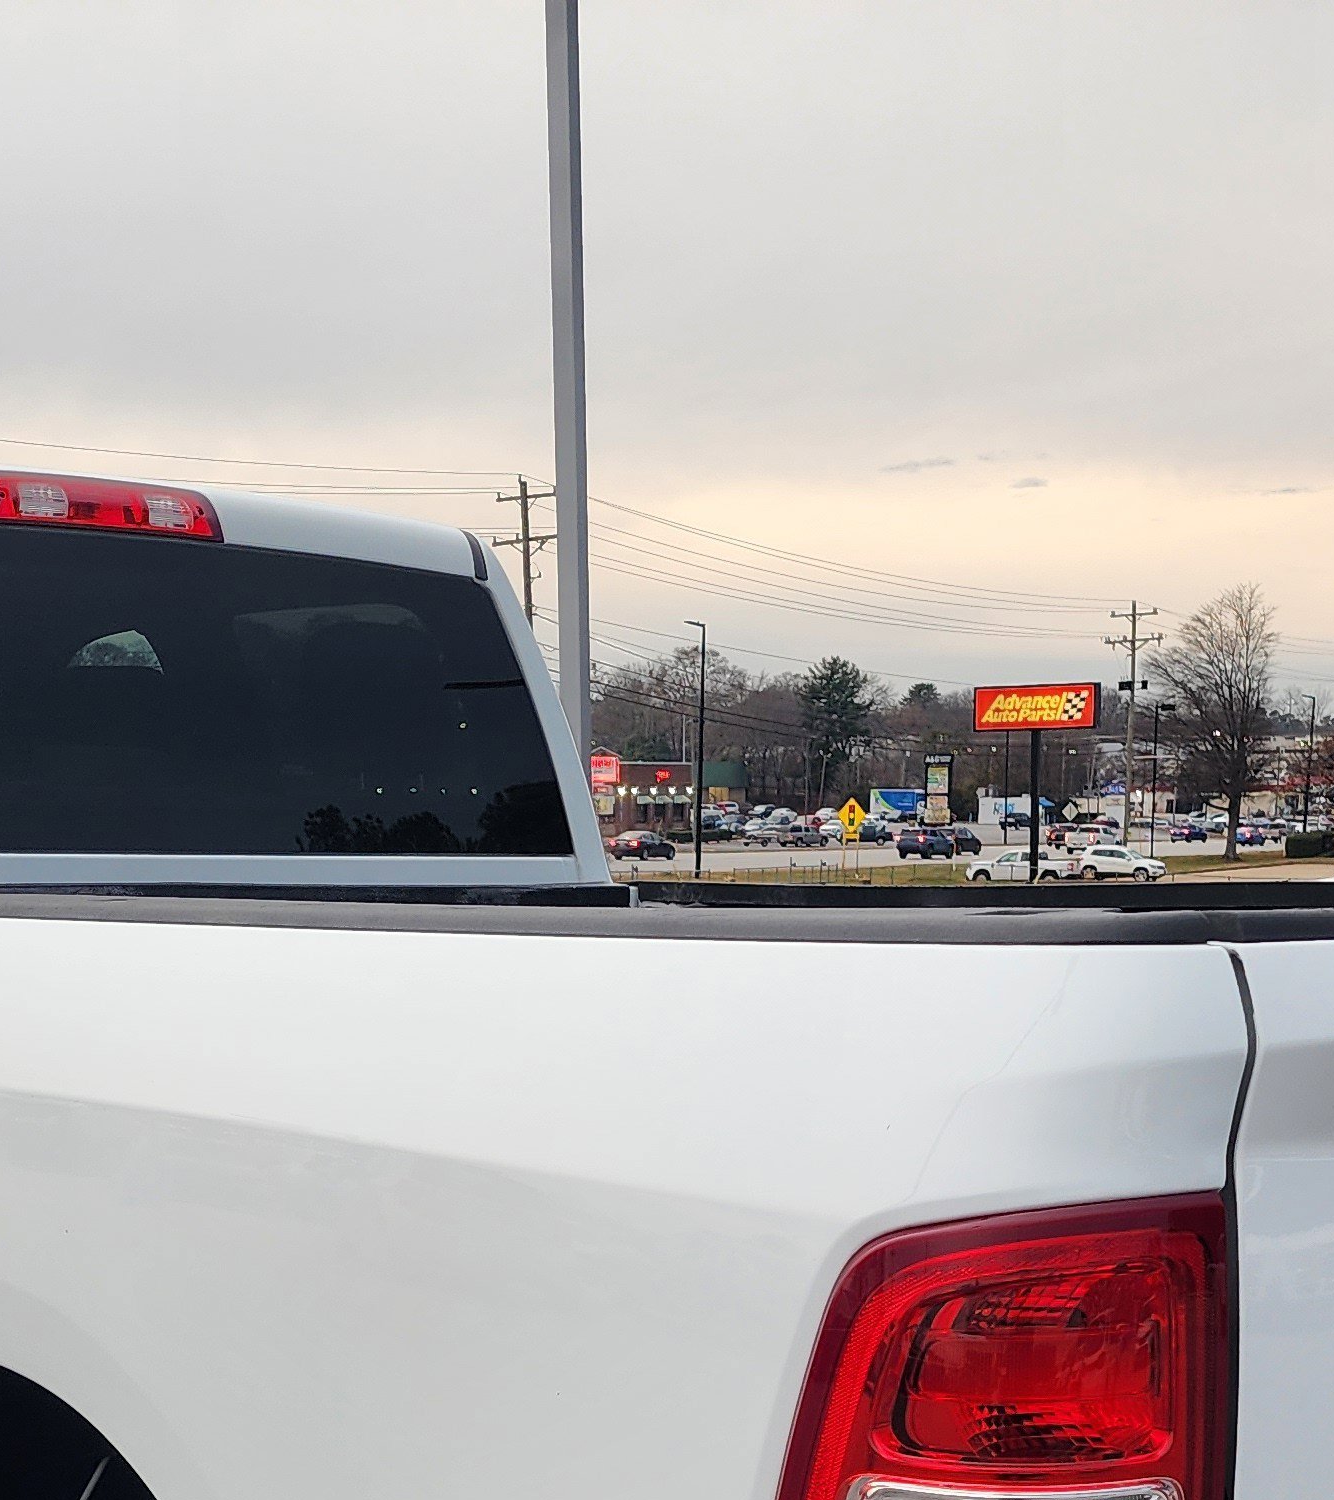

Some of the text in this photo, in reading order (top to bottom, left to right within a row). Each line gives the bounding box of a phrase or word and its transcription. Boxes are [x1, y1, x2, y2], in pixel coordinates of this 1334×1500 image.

[989, 693, 1061, 710] Advance
[981, 708, 1058, 723] Auto Parts
